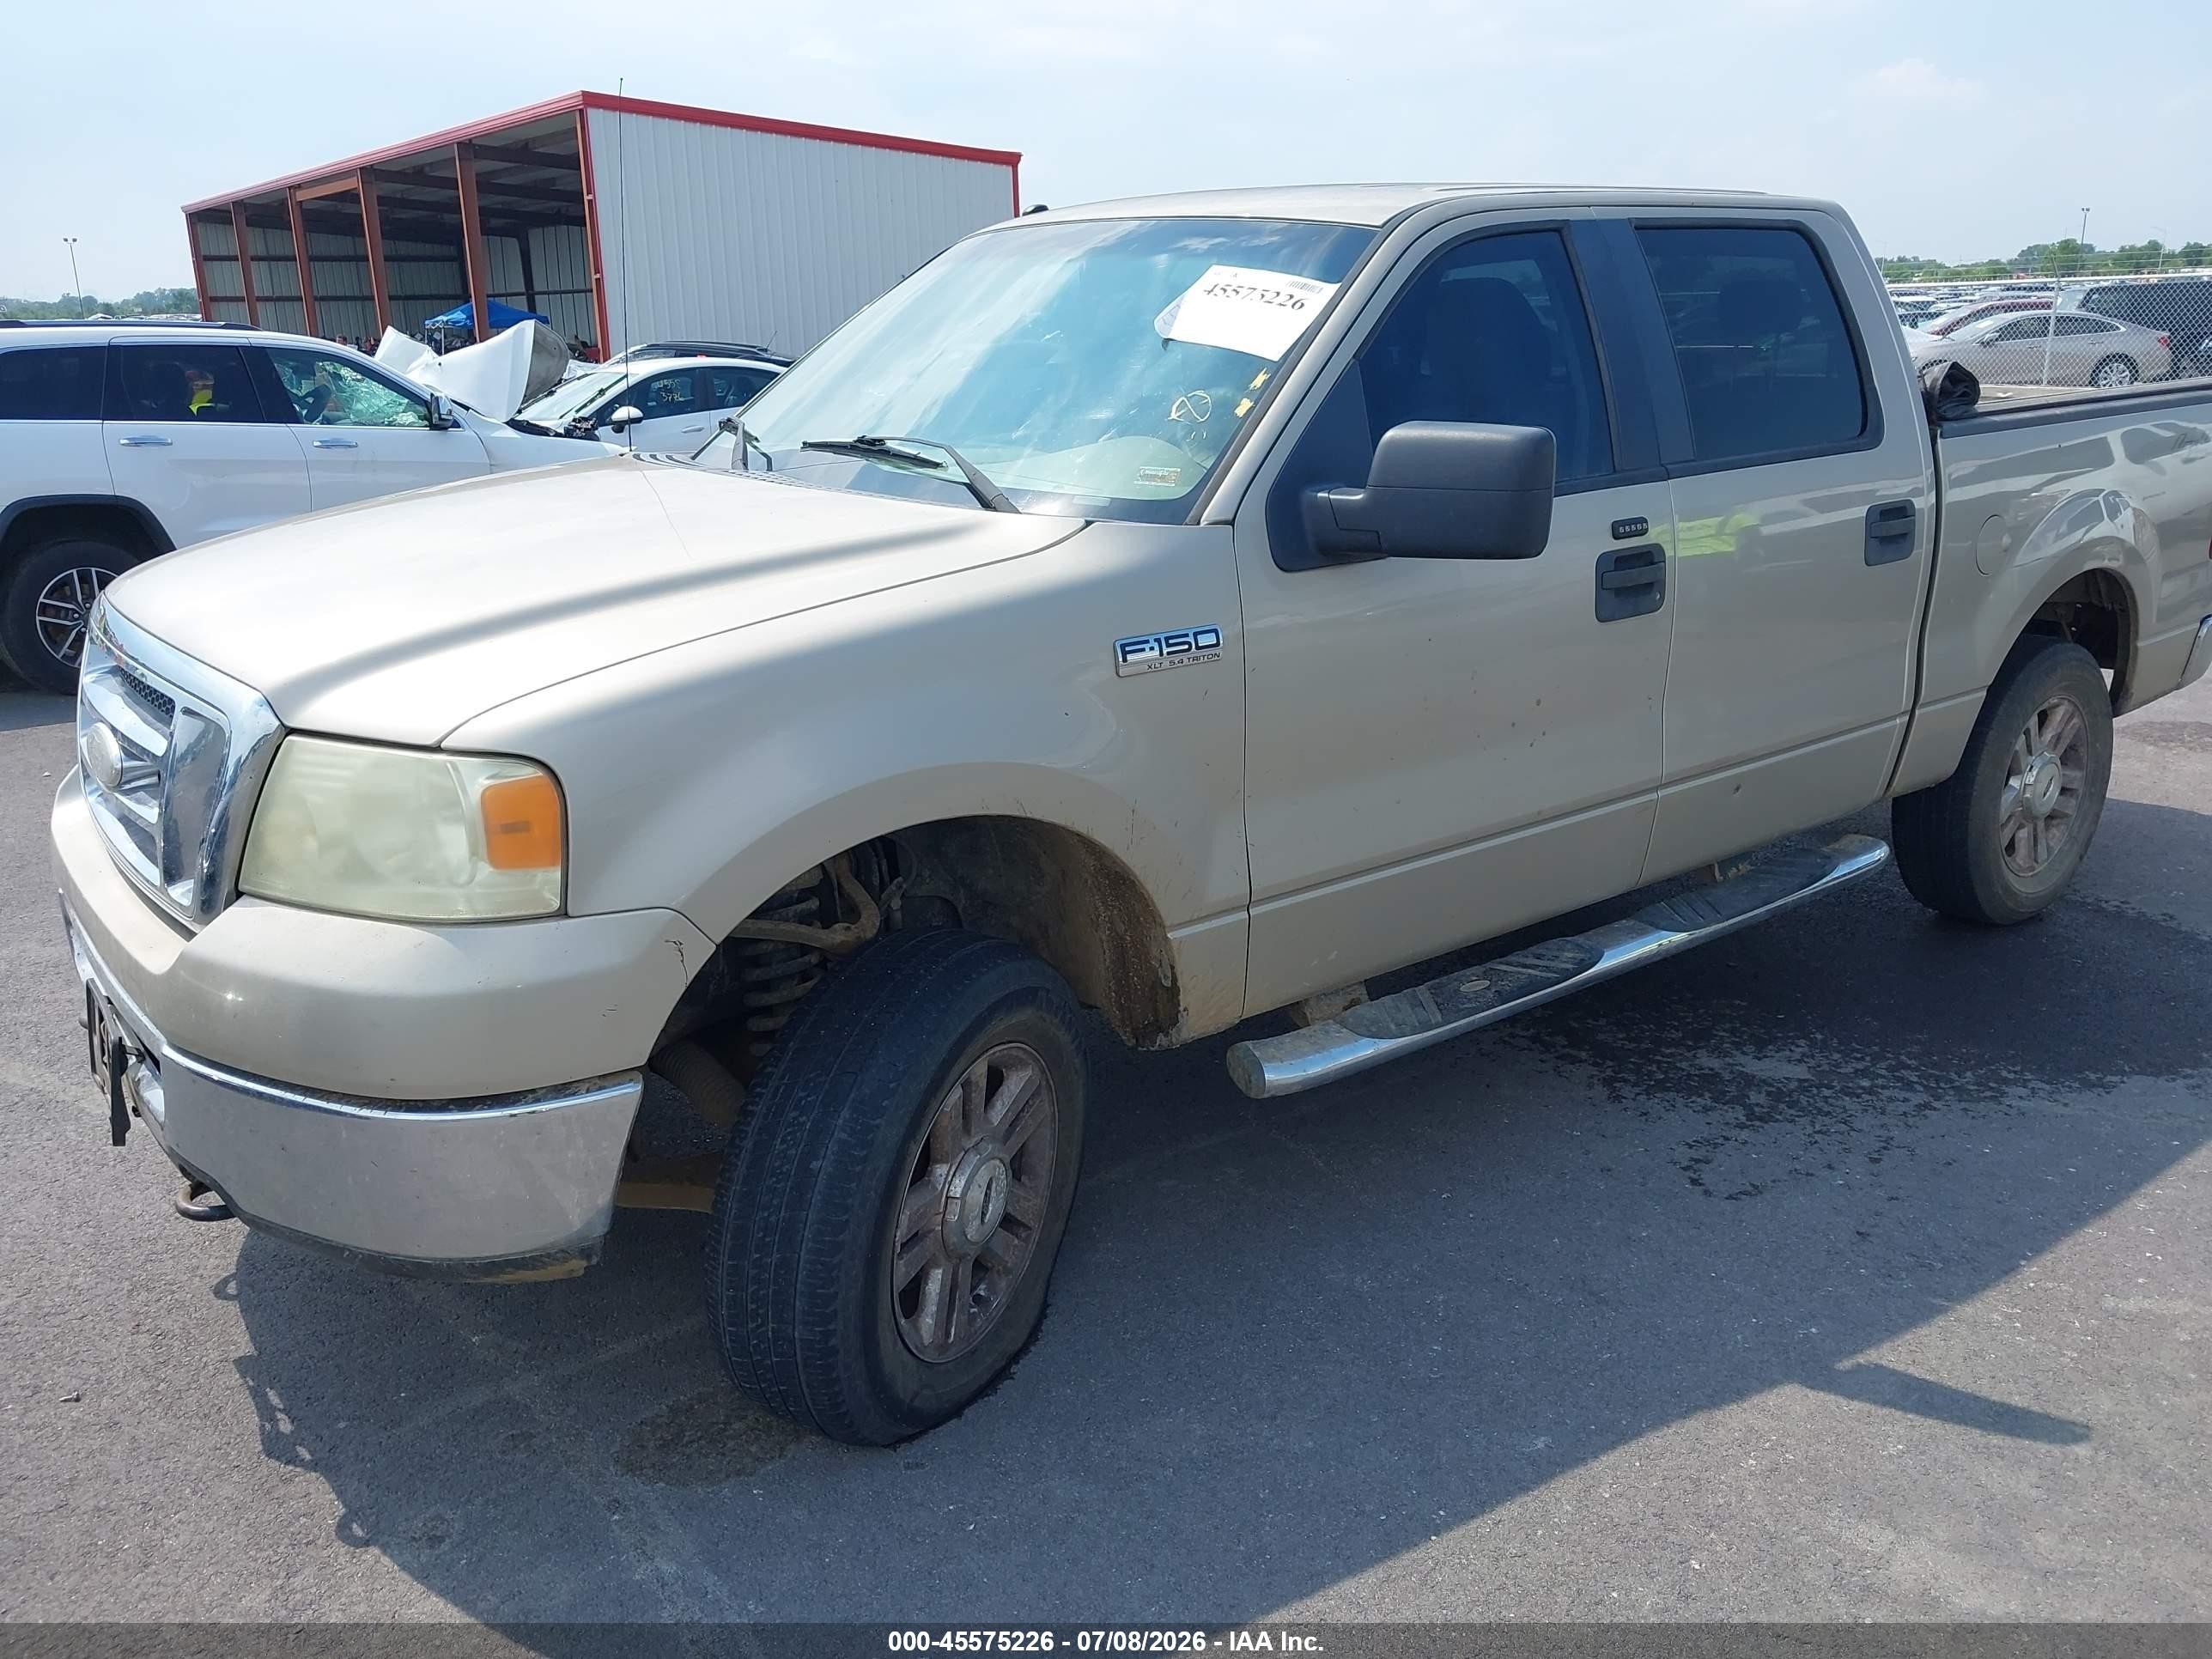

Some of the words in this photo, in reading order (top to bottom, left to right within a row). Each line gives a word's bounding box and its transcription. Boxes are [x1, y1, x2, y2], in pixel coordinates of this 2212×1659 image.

[1203, 283, 1307, 310] 45575226
[1147, 662, 1164, 671] XLT
[1169, 658, 1184, 666] 5.4
[1187, 653, 1221, 664] TRITON
